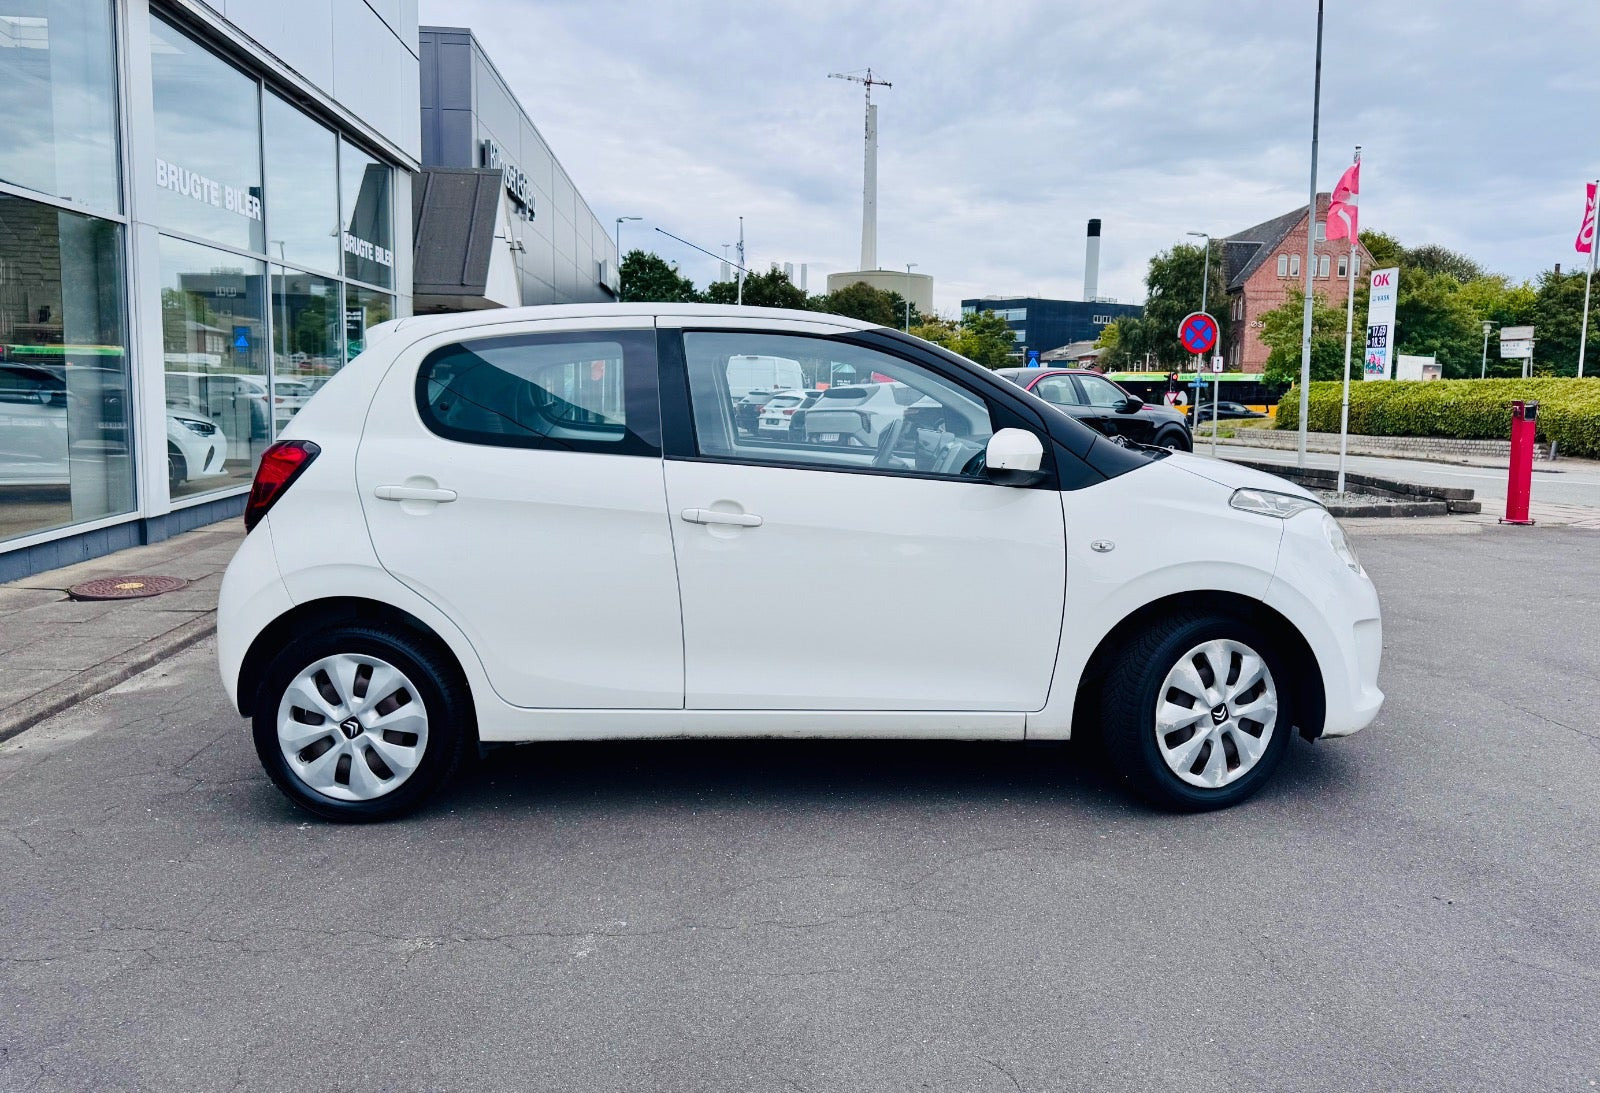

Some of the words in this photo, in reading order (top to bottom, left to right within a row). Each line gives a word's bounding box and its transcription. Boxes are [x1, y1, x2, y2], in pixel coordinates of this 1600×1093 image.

[156, 158, 220, 207] BRUGTE
[224, 185, 262, 221] BILER
[344, 232, 374, 261] BRUGTE
[1373, 273, 1391, 287] OK
